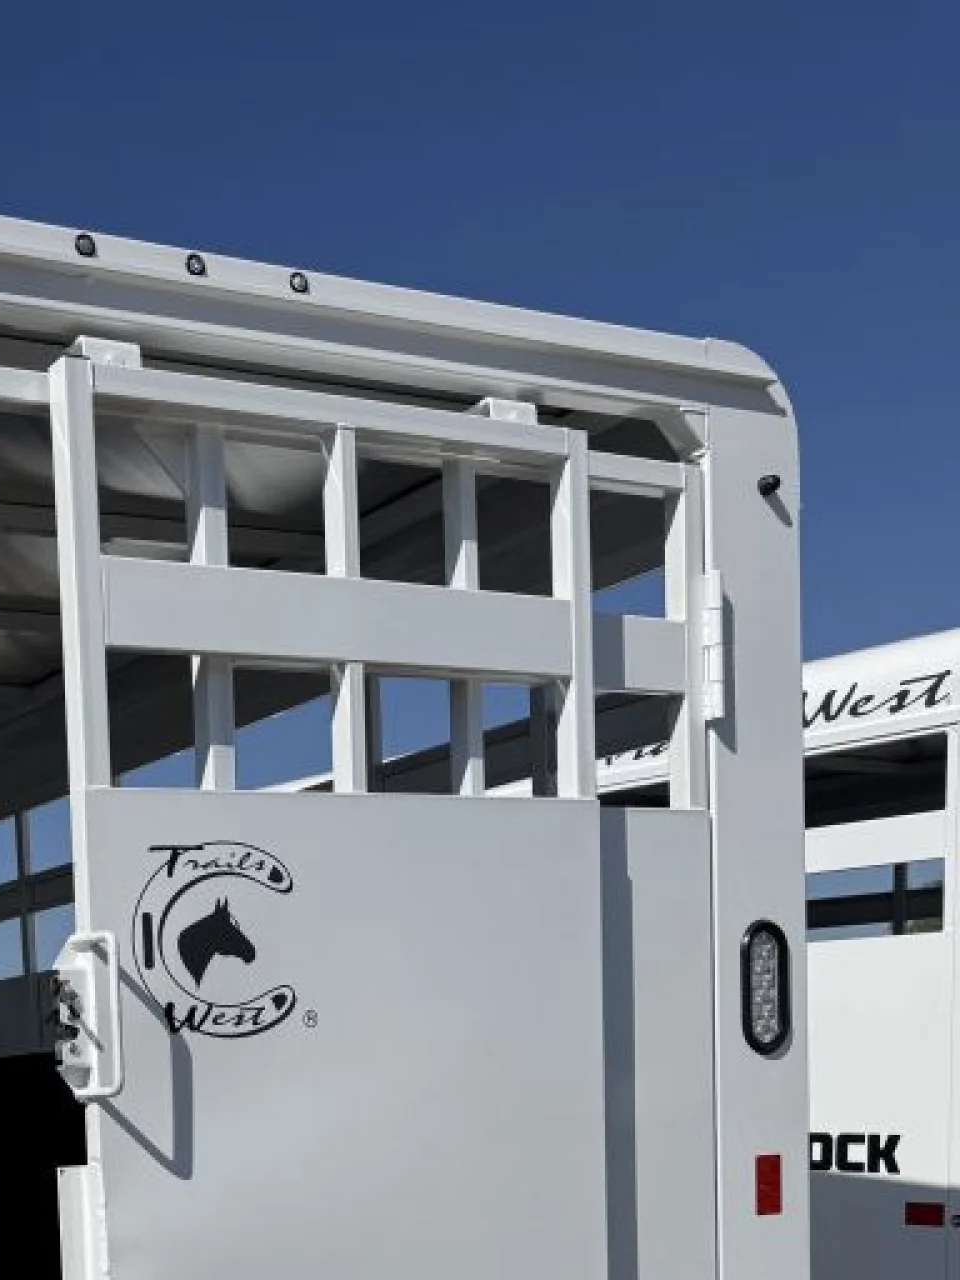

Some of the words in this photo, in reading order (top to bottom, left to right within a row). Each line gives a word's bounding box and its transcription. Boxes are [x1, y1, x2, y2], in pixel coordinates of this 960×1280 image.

[802, 669, 952, 729] West
[148, 844, 266, 878] Trails
[164, 1001, 266, 1034] West
